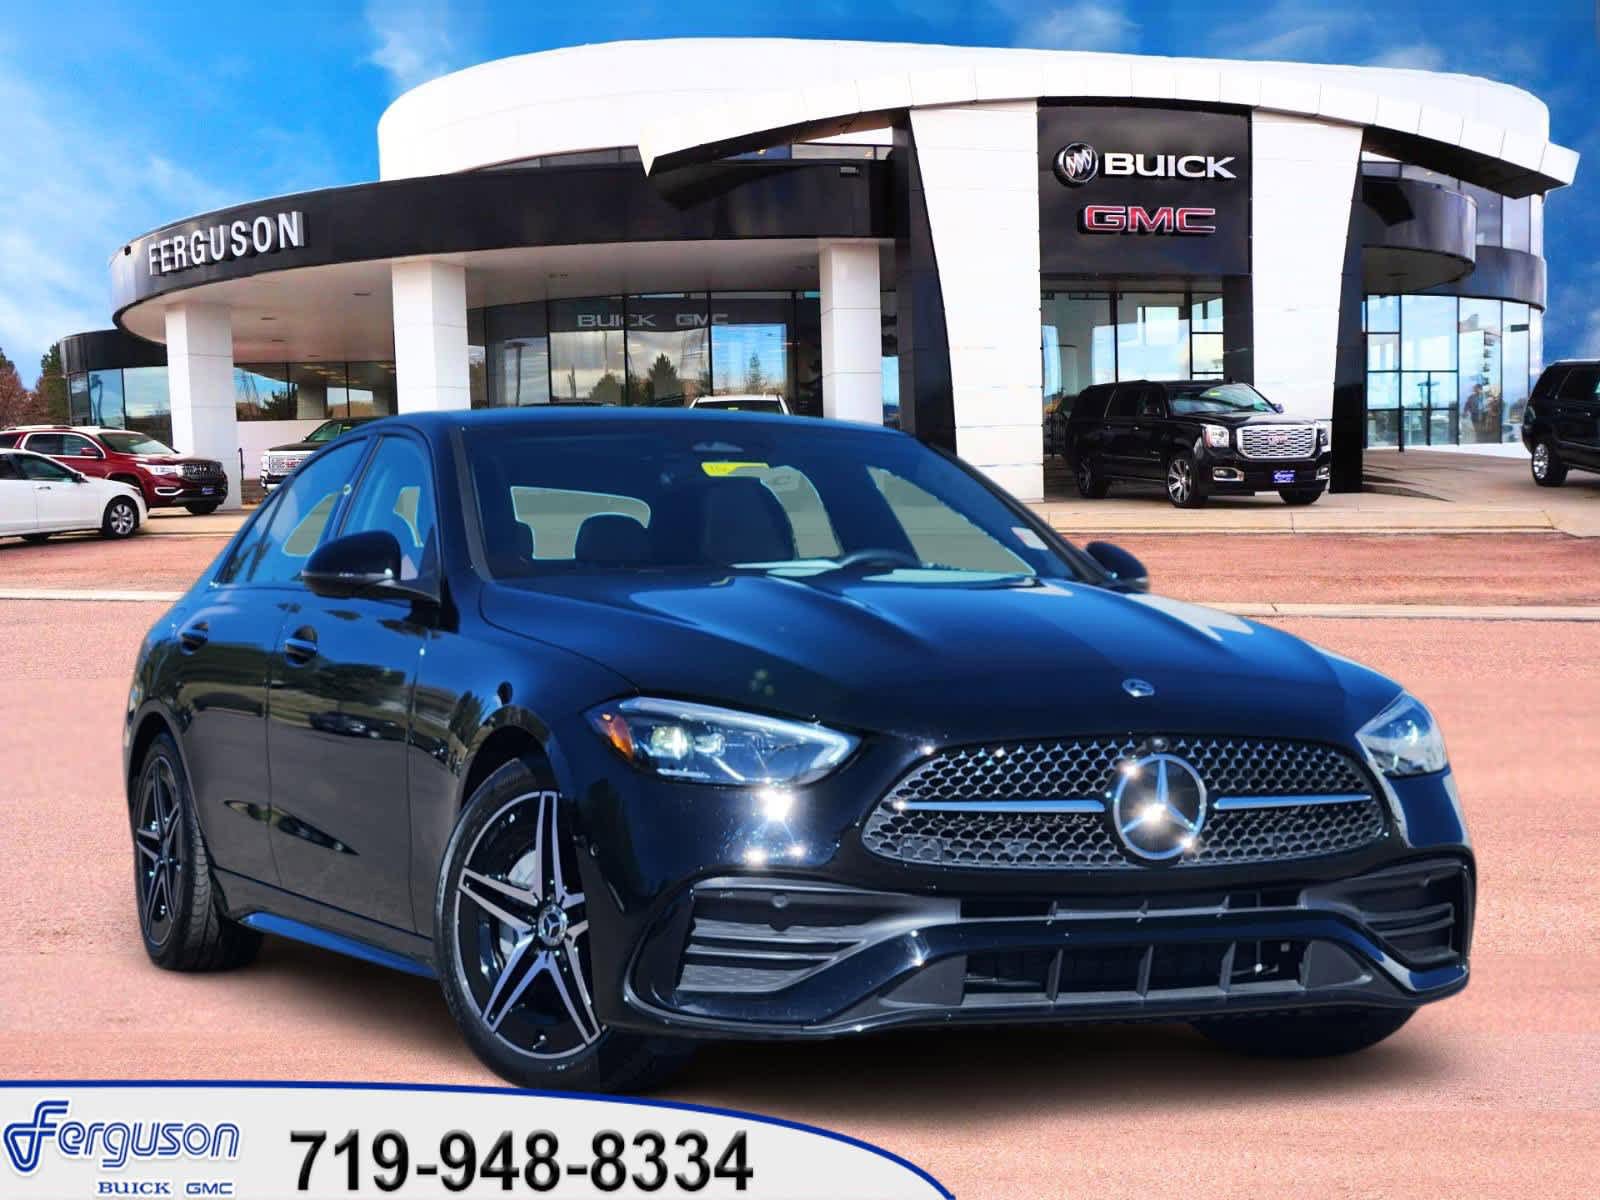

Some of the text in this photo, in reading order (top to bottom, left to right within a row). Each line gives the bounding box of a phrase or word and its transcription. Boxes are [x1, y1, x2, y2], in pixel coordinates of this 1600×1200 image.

[1104, 152, 1237, 179] BUICK
[1084, 205, 1217, 233] GMC
[148, 211, 304, 276] FERGUSON
[577, 313, 729, 328] BUICK GMC
